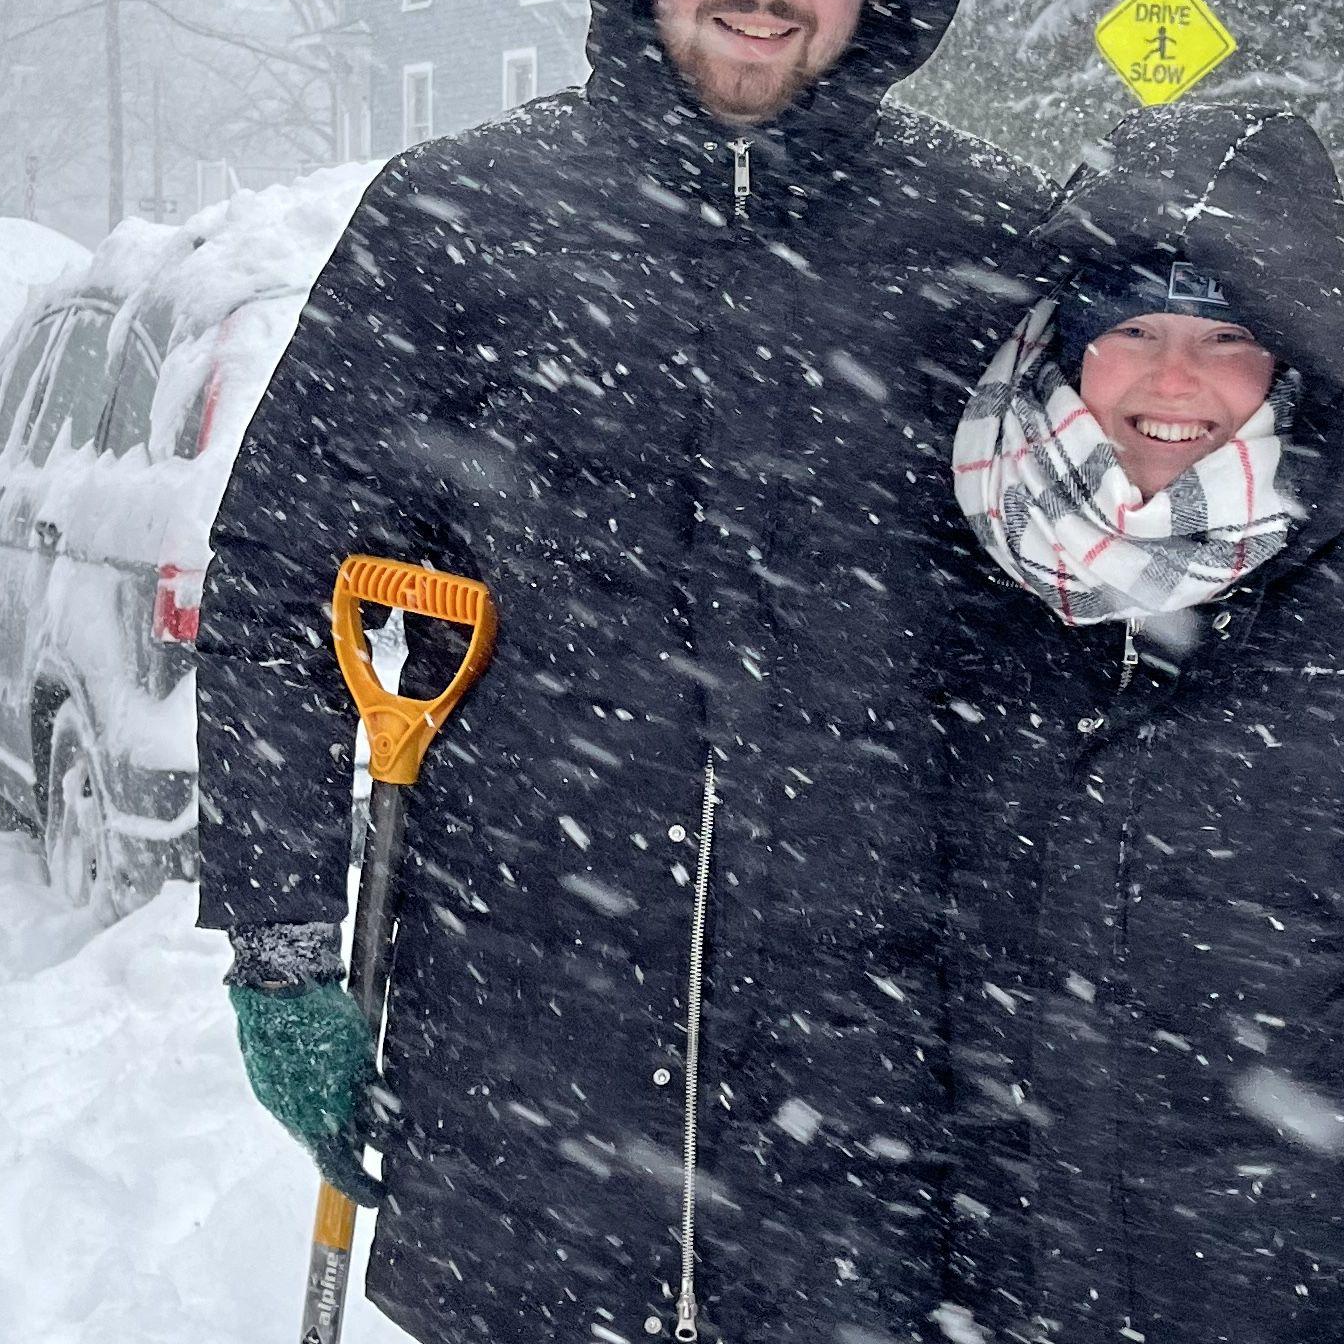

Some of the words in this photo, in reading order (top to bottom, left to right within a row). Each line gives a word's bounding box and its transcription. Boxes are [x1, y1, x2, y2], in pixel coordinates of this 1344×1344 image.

[1134, 2, 1191, 26] DRIVE
[1130, 62, 1185, 84] SLOW
[317, 1251, 340, 1327] alpine
